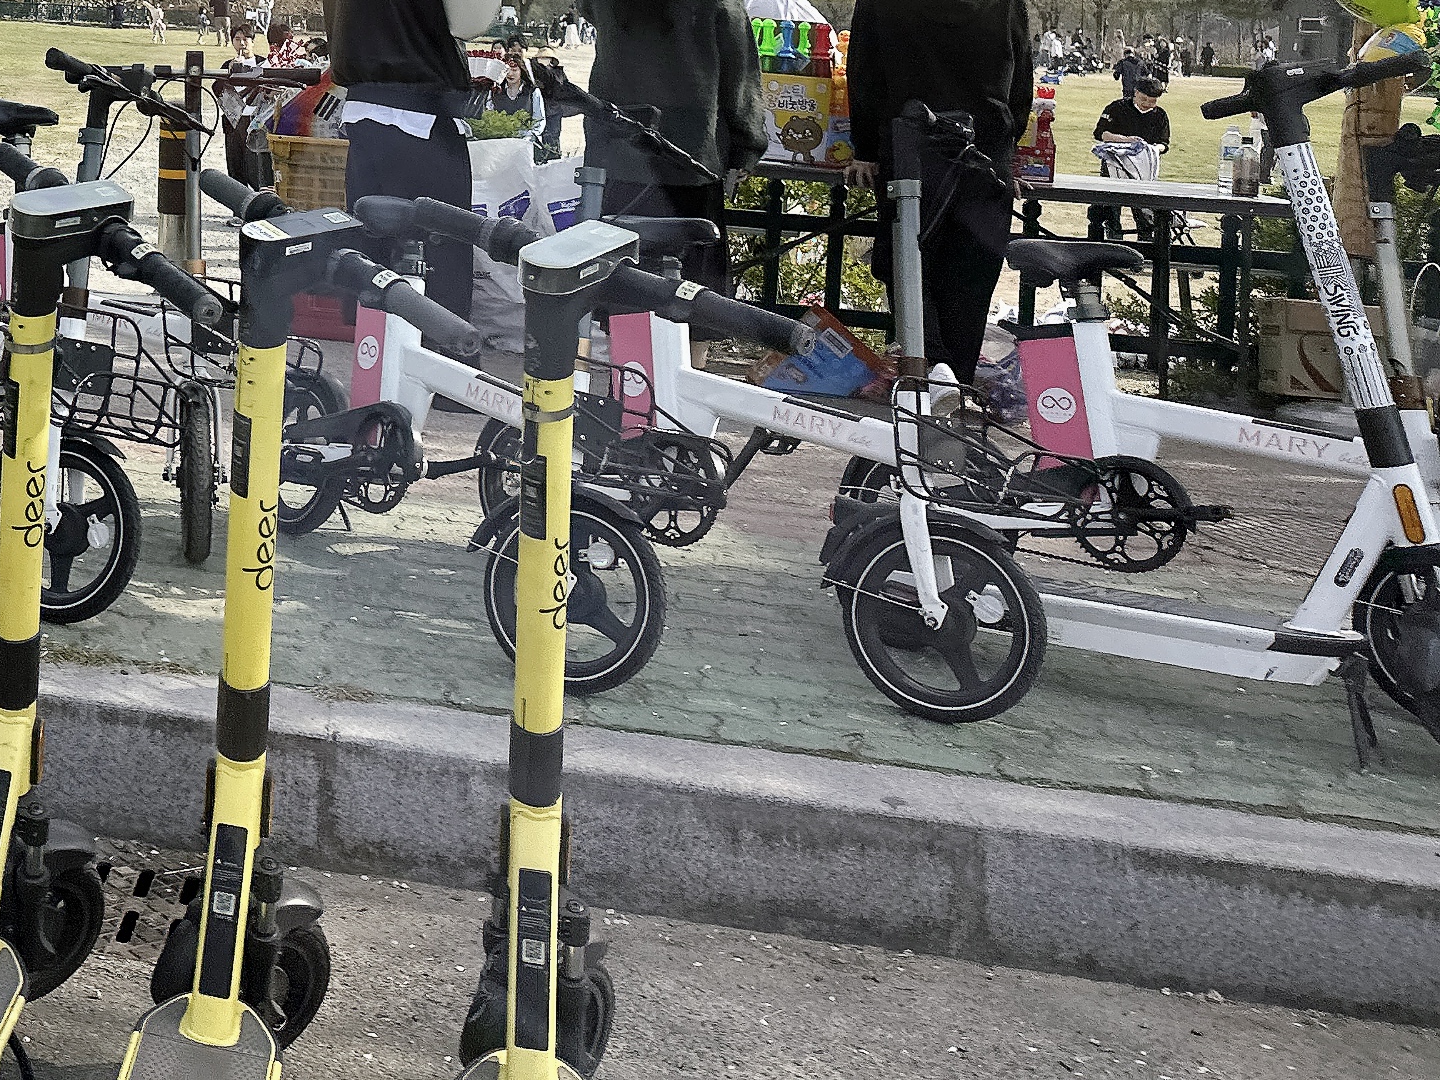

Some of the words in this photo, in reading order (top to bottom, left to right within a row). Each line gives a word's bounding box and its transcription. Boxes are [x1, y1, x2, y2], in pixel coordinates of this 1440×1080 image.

[1238, 426, 1331, 460] MARY
[11, 459, 47, 548] deer
[242, 498, 278, 591] deer
